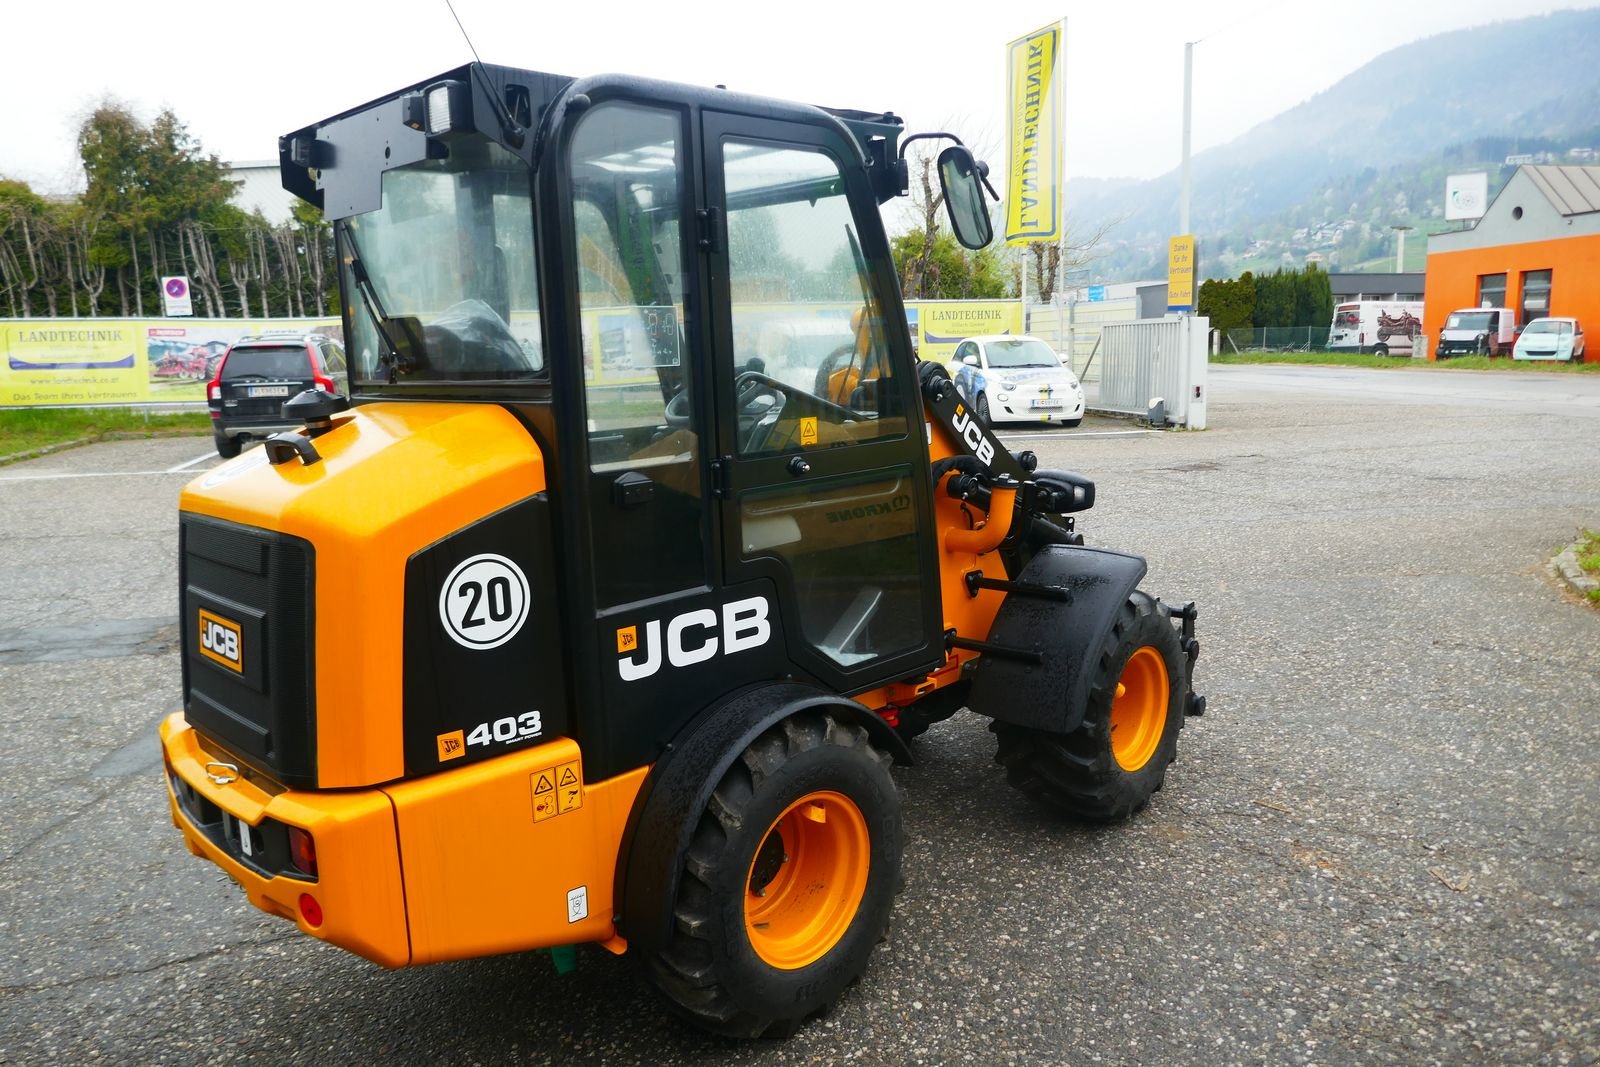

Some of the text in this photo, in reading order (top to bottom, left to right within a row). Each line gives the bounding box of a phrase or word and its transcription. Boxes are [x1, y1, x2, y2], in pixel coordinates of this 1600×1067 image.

[932, 310, 1002, 320] LANDTECHNIK
[18, 330, 122, 343] LANDTECHNIK
[13, 393, 31, 401] Das
[35, 392, 59, 401] Team
[952, 412, 995, 467] JCB
[458, 576, 513, 629] 20
[202, 621, 239, 661] JCB
[617, 596, 771, 682] JCB
[443, 739, 460, 753] JCB
[466, 710, 542, 746] 403
